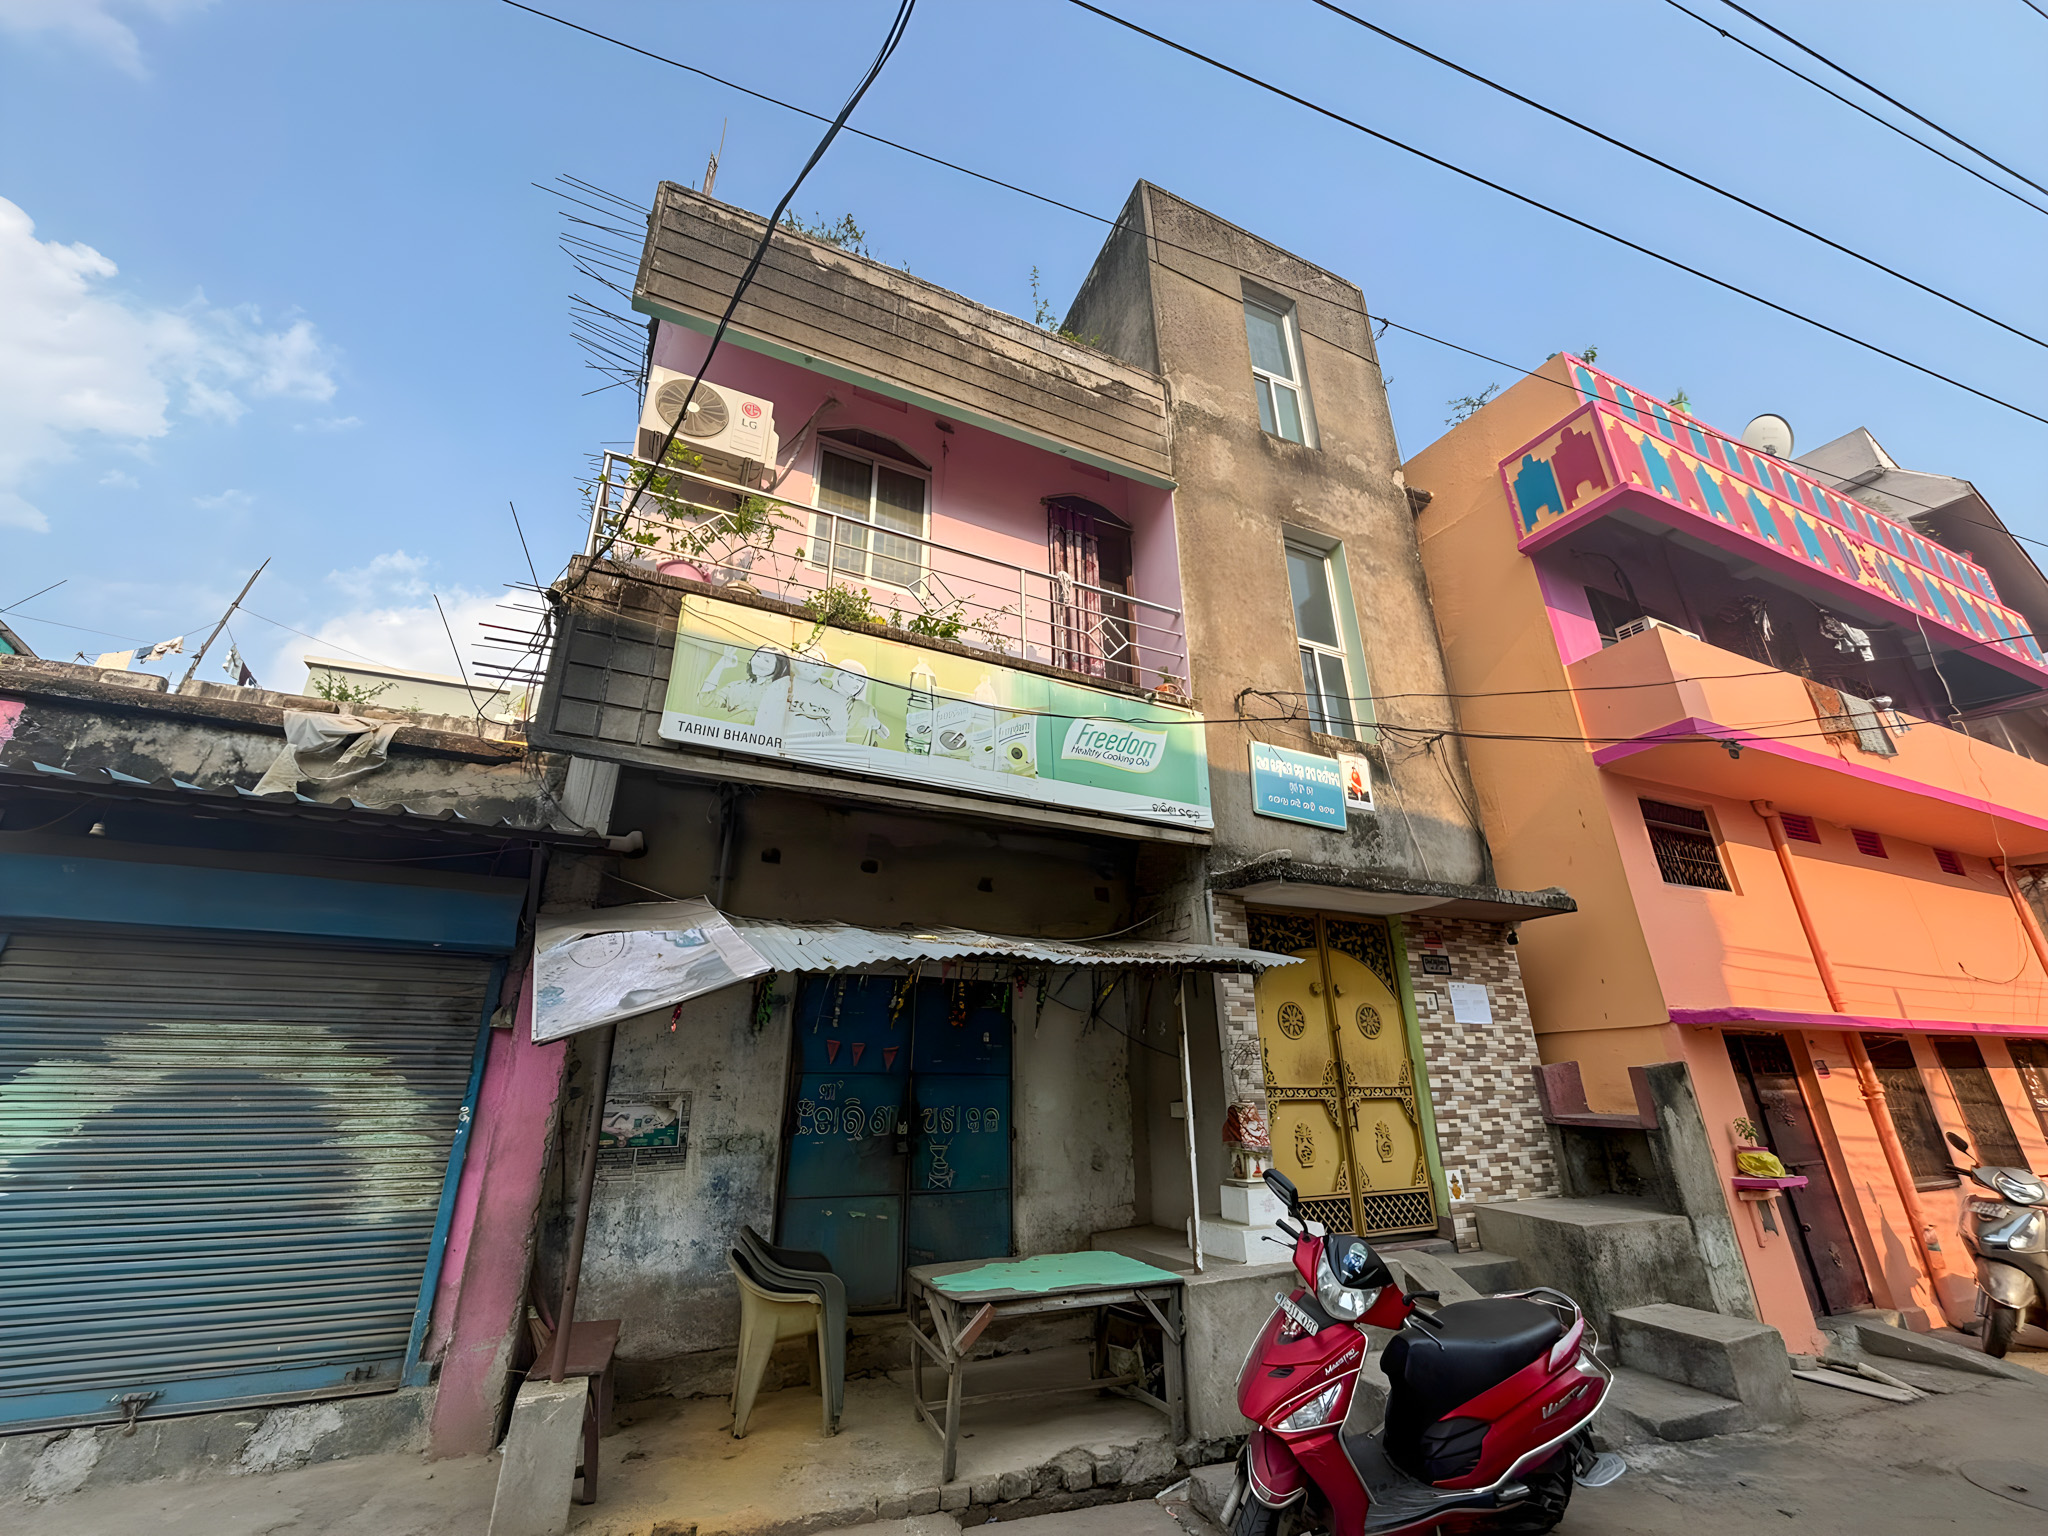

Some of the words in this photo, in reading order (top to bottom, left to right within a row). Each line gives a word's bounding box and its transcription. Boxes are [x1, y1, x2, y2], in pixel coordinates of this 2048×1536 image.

[741, 418, 758, 430] LG
[678, 720, 720, 738] TARINI
[723, 729, 783, 749] BHANDAR
[1075, 723, 1157, 759] Freedom
